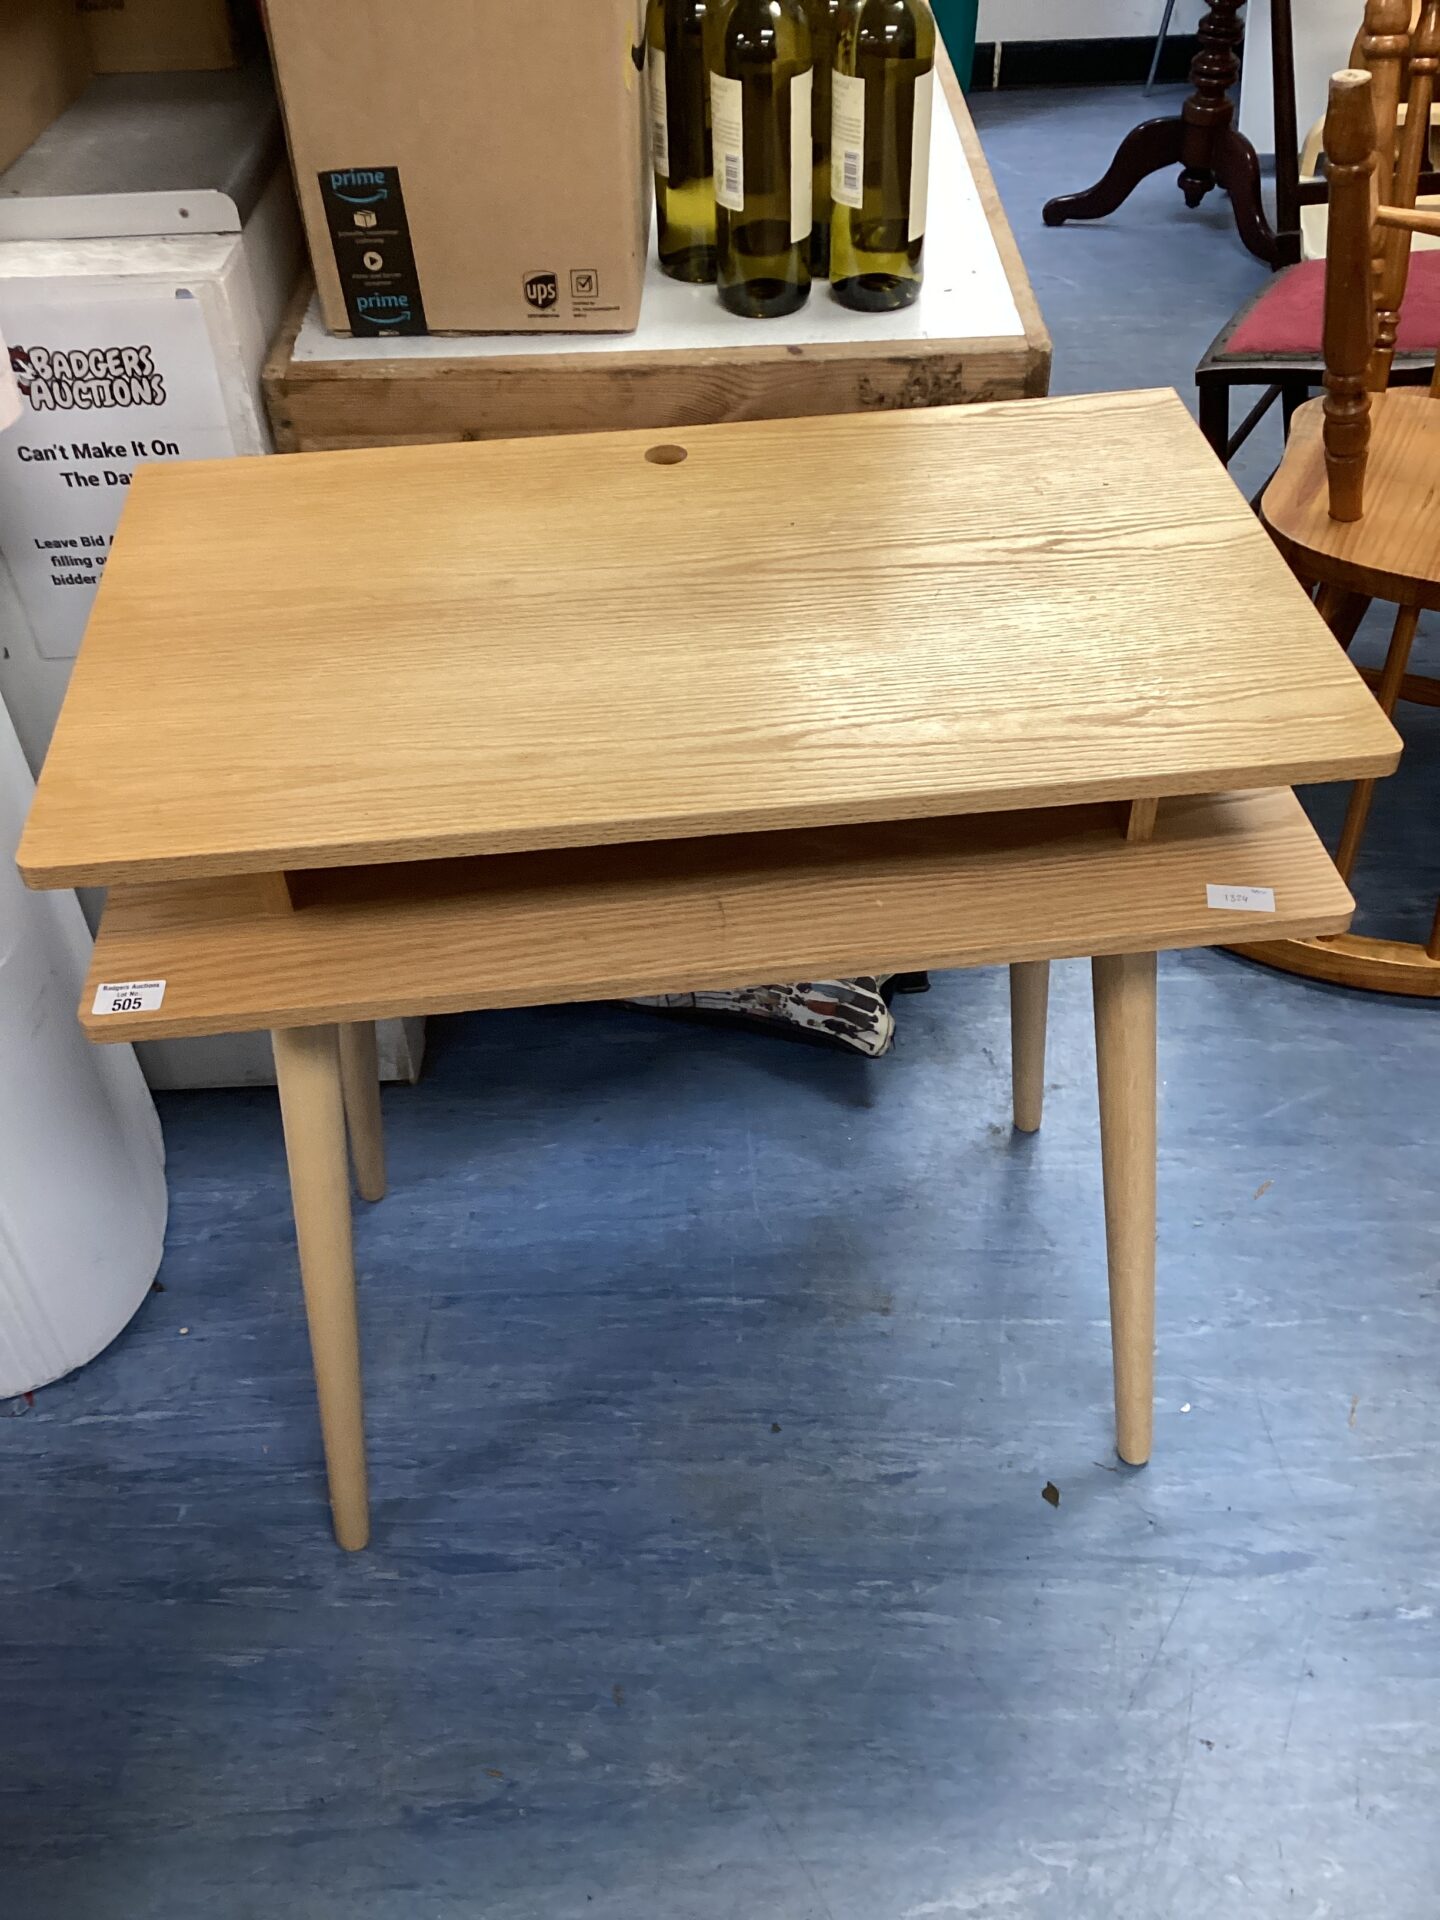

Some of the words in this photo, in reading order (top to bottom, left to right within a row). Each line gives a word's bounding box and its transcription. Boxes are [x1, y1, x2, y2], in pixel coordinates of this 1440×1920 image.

[330, 168, 385, 190] prime
[356, 292, 409, 313] prime
[526, 283, 556, 305] ups
[27, 345, 155, 380] BADGERS
[30, 374, 166, 411] AUCTIONS
[17, 444, 69, 462] Can't
[72, 441, 127, 459] Make
[131, 440, 148, 457] It
[151, 439, 180, 456] On
[60, 471, 100, 488] The
[103, 470, 133, 486] Da
[34, 538, 78, 550] Leave
[80, 535, 105, 548] Bid
[51, 555, 93, 569] filling
[51, 573, 97, 586] bidder
[112, 997, 142, 1011] 505
